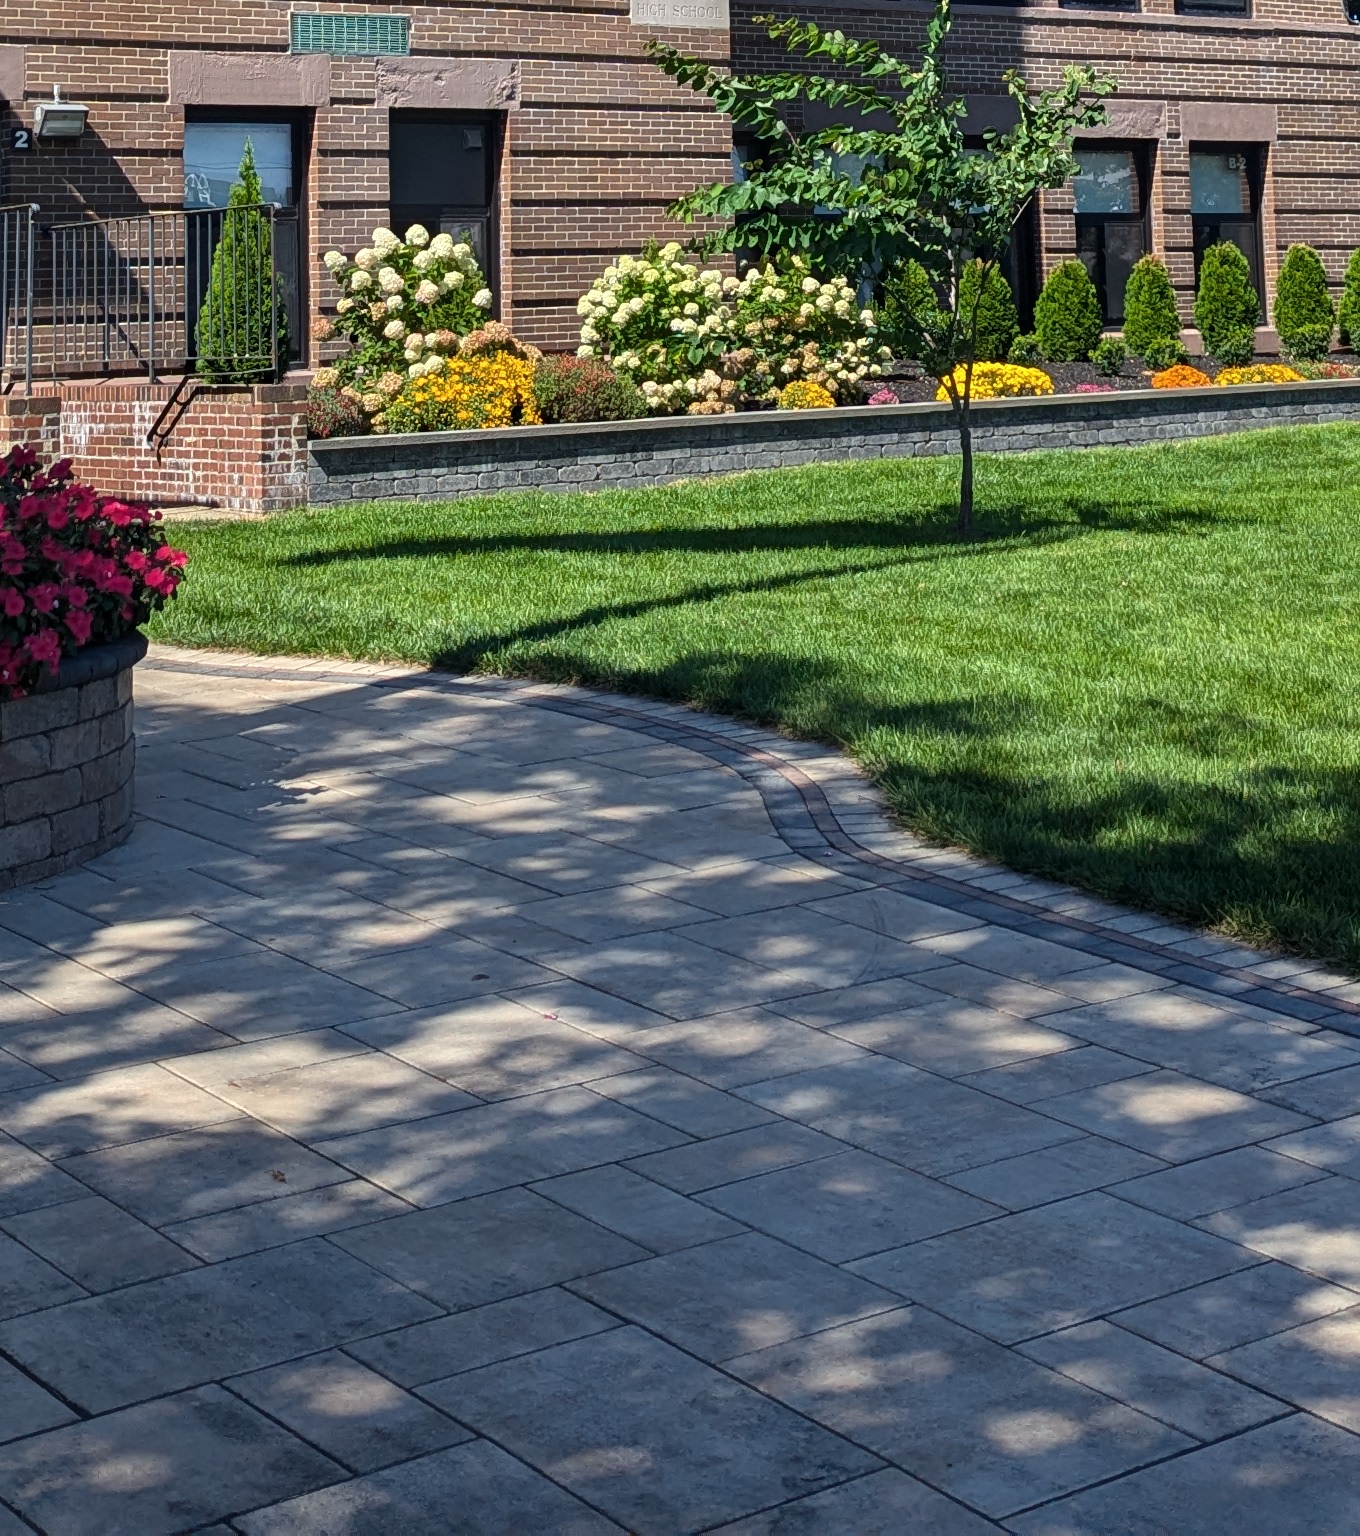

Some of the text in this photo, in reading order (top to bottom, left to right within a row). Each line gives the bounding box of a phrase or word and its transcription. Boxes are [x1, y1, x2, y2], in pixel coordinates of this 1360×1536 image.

[636, 2, 724, 19] HIGH SCHOOL
[14, 130, 29, 148] 2
[1228, 157, 1247, 169] B-2
